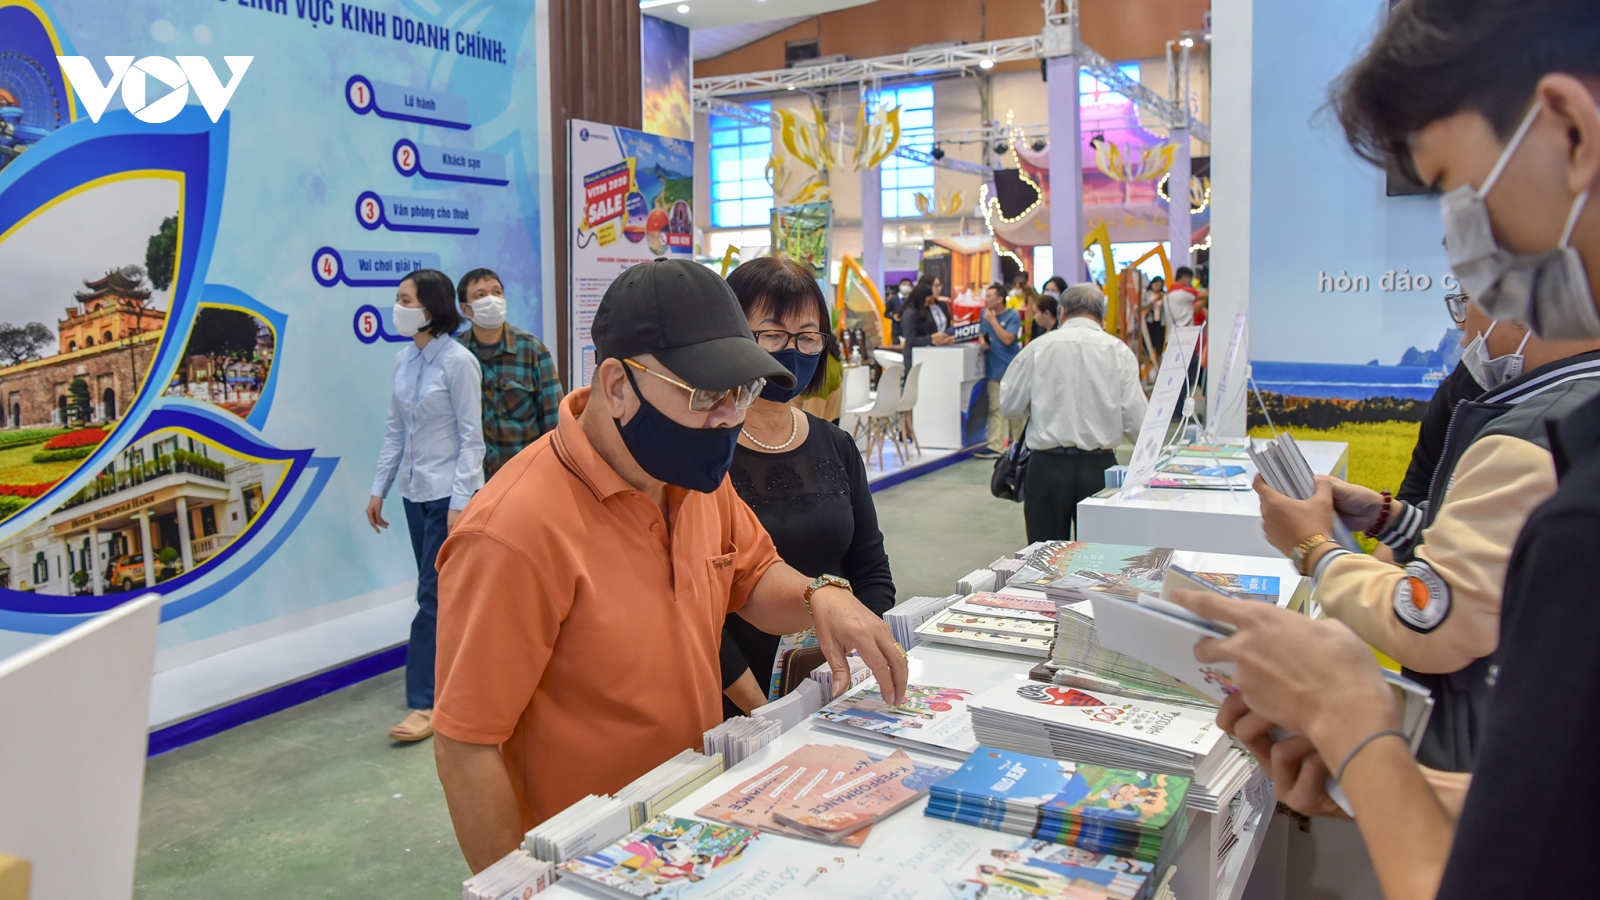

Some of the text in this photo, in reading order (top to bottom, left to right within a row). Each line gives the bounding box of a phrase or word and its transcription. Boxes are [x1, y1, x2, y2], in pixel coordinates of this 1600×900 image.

[341, 3, 387, 38] KINH
[392, 15, 450, 51] DOANH
[455, 31, 507, 65] CHÍNH:
[357, 86, 364, 104] 1
[416, 96, 436, 111] hành
[402, 149, 411, 167] 2
[442, 153, 481, 171] Khách sạn
[608, 175, 628, 190] 2020
[366, 202, 375, 220] 3
[393, 203, 470, 220] Văn phòng cho thuê
[588, 193, 623, 226] SALE
[323, 258, 332, 277] 4
[359, 259, 372, 272] Vui
[374, 258, 394, 272] chơi
[395, 258, 411, 274] giải
[1318, 269, 1369, 293] hòn
[1378, 268, 1432, 292] đảo
[364, 316, 372, 333] 5
[1089, 707, 1125, 725] 100
[808, 766, 911, 815] K-PERFORMANCE
